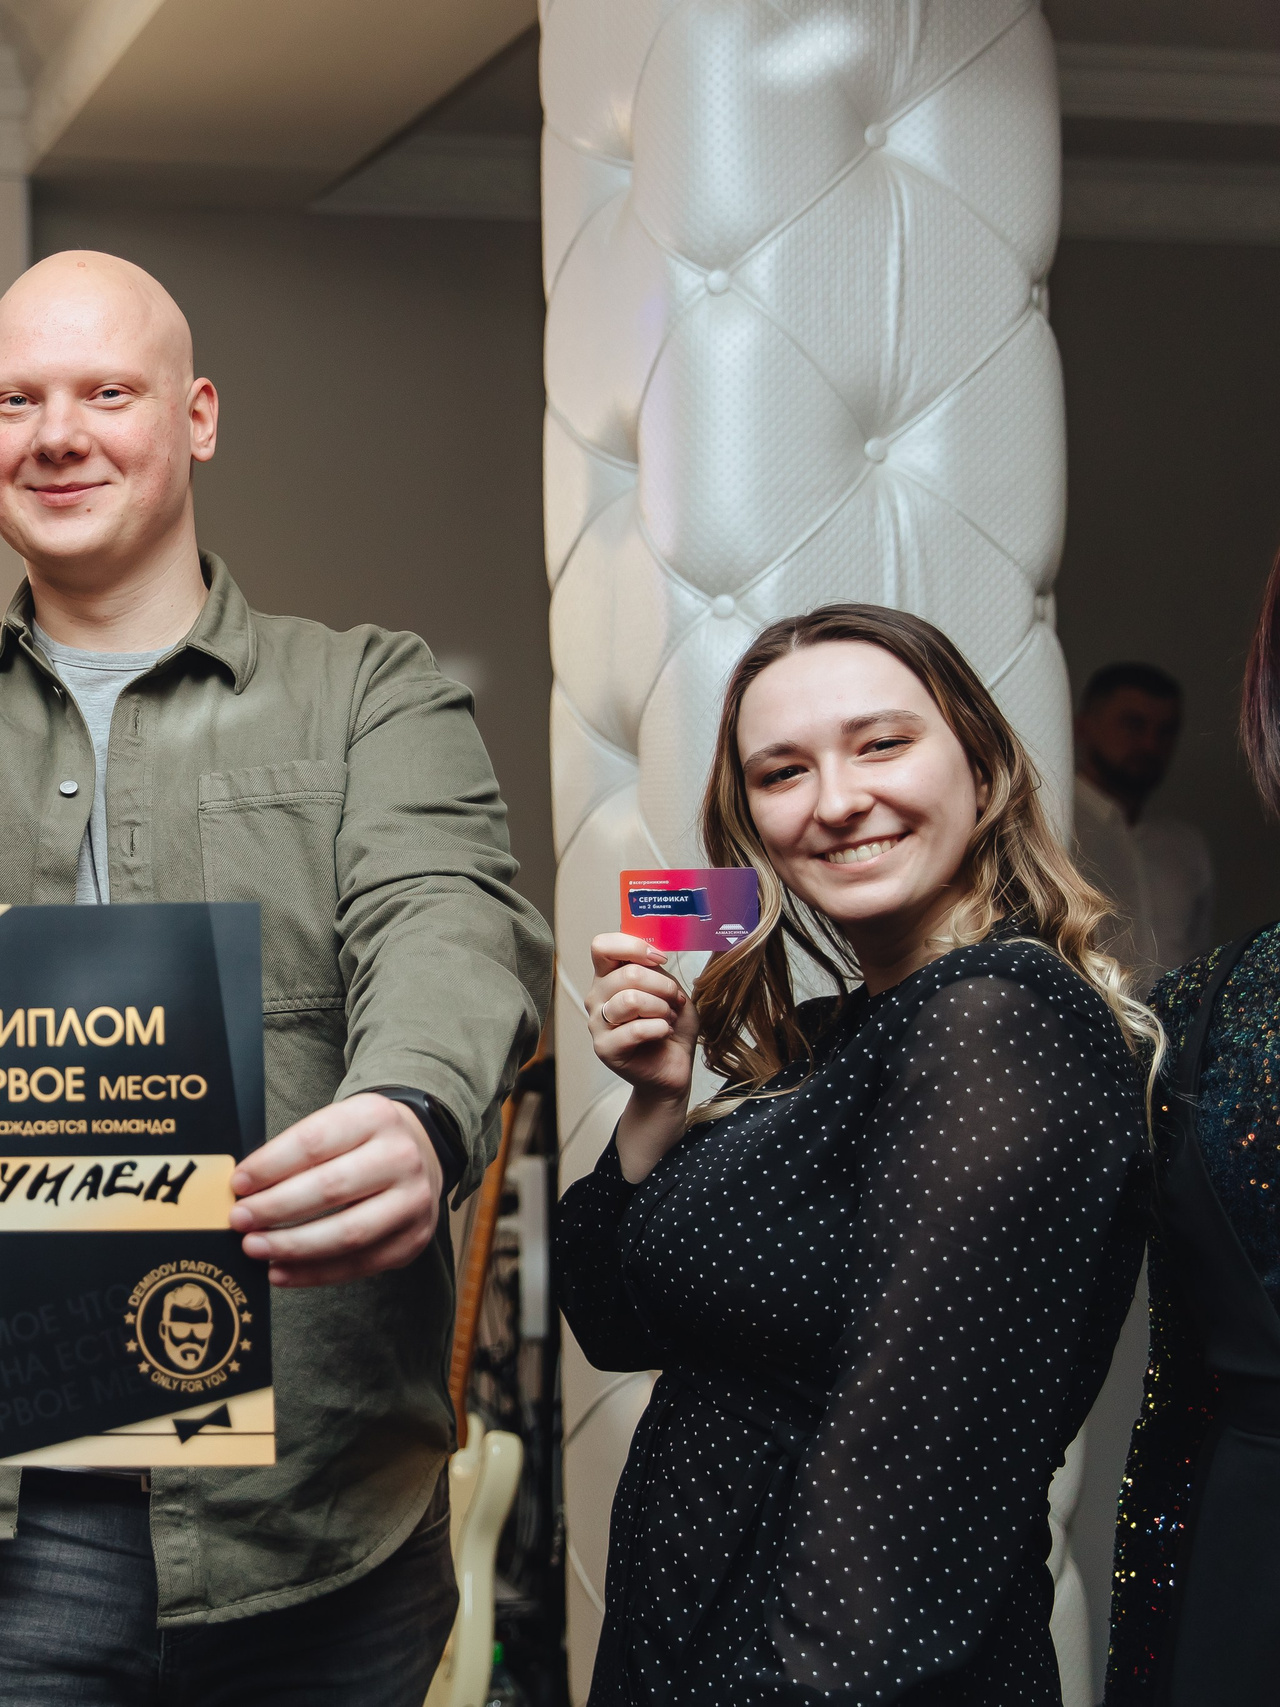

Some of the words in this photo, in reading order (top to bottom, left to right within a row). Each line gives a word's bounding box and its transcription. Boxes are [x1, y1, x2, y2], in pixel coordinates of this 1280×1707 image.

[639, 895, 689, 903] СЕРТИФИКАТ
[98, 1074, 208, 1101] МЕСТО
[91, 1117, 176, 1135] команда
[127, 1261, 178, 1307] DEMIDOV
[179, 1259, 224, 1279] PARTY
[221, 1275, 248, 1306] QUIZ
[66, 1282, 132, 1325] ЧТО
[0, 1350, 50, 1392] НА
[150, 1370, 179, 1391] ONLY
[180, 1380, 204, 1393] FOR
[203, 1370, 228, 1388] YOU
